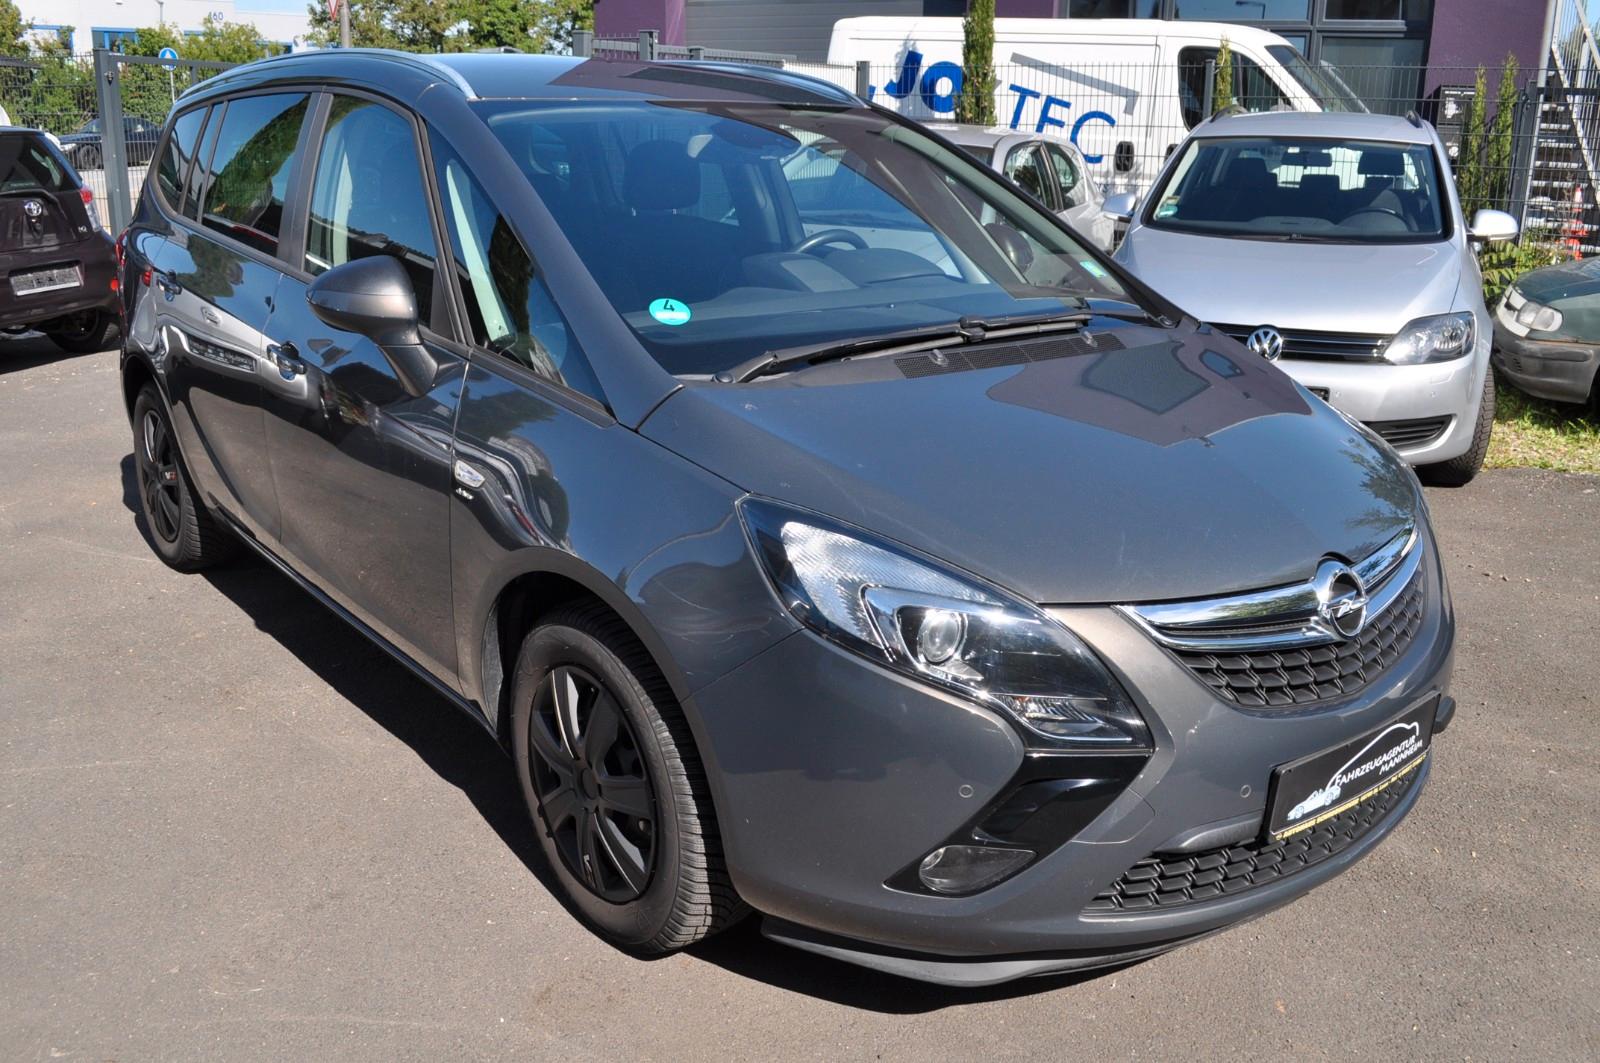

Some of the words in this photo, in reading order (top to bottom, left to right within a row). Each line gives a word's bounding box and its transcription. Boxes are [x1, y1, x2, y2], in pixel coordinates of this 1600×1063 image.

[663, 299, 675, 312] 4
[1335, 735, 1416, 787] FAHRZEUGAGENTUR
[1379, 739, 1423, 776] MANNHEIM
